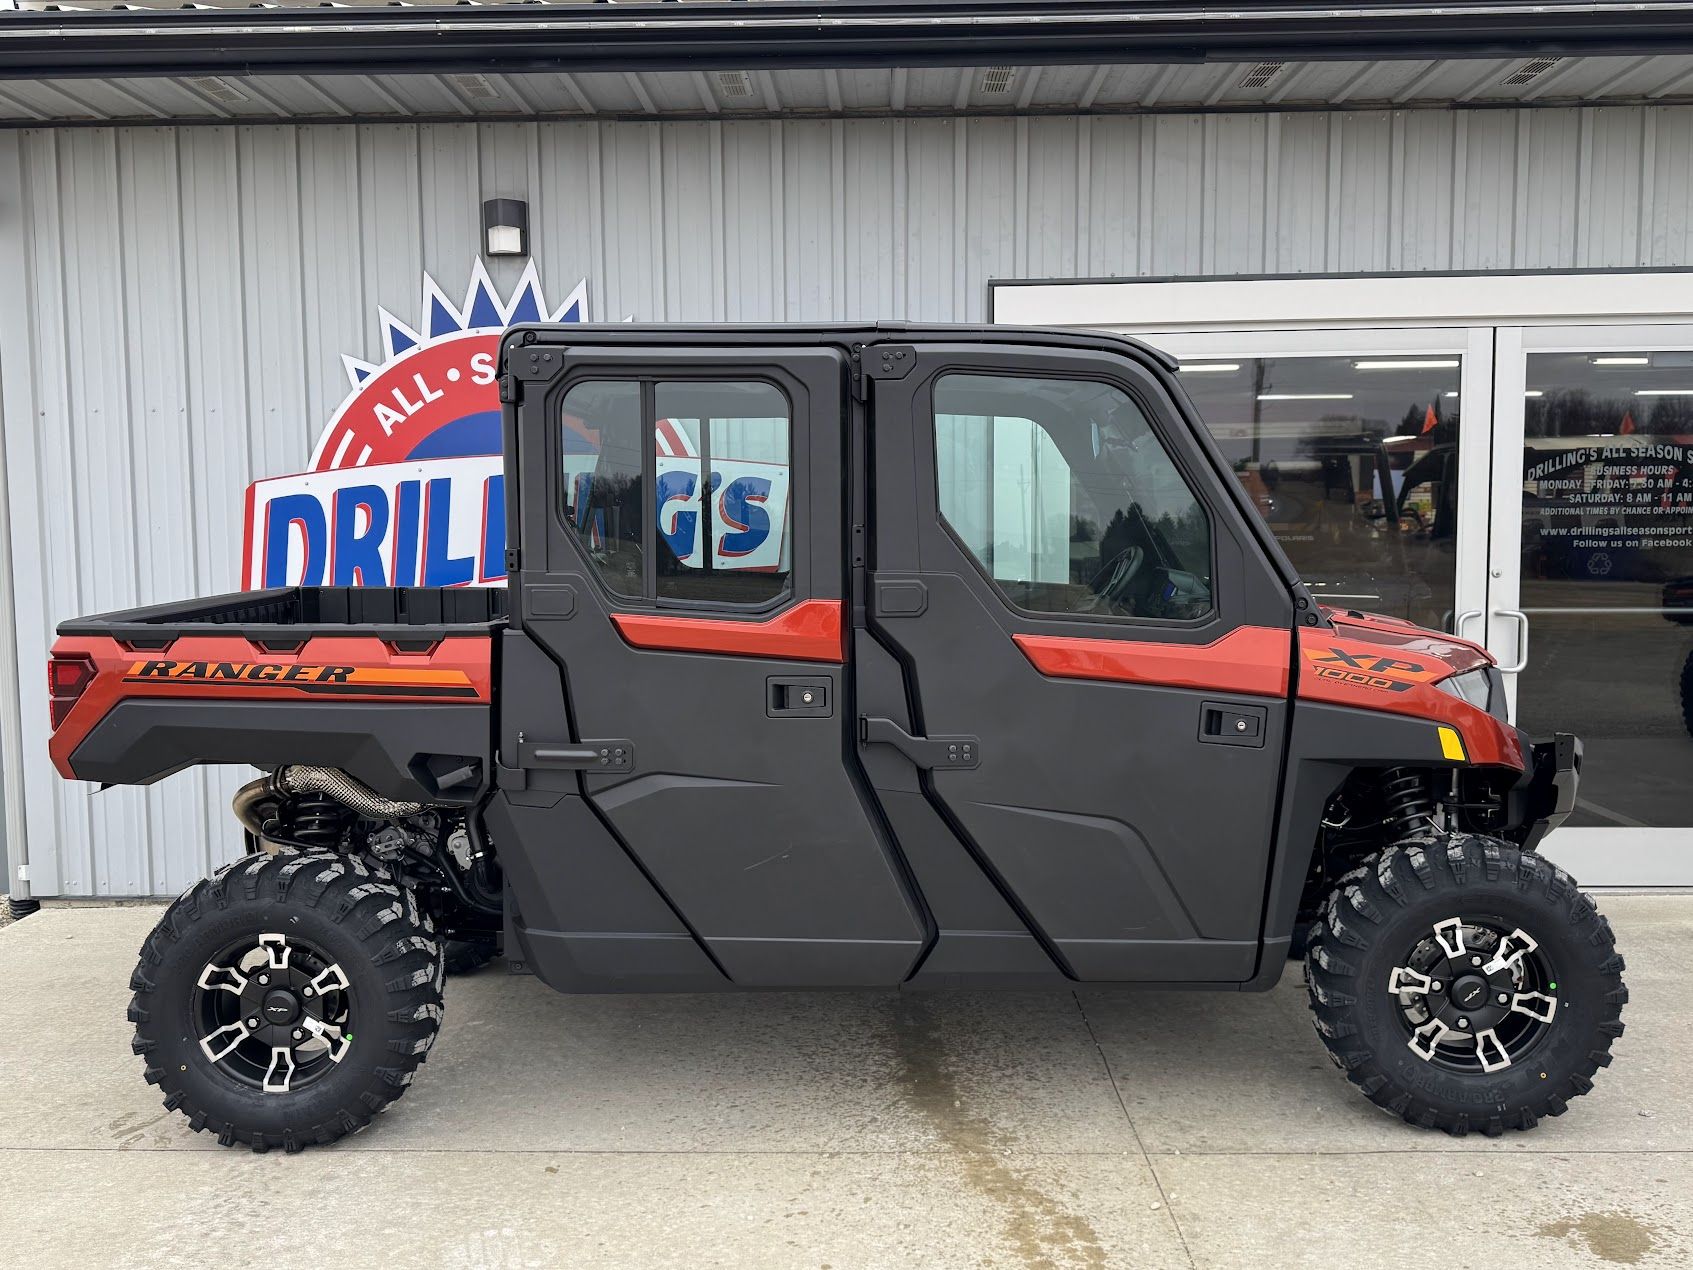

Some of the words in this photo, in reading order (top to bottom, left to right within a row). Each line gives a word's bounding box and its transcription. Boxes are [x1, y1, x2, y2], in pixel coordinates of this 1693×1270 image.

[373, 373, 444, 437] ALL
[1527, 447, 1598, 482] DRILLING'S
[1602, 445, 1626, 459] ALL
[1630, 444, 1683, 461] SEASON
[1590, 465, 1638, 476] BUSINESS
[1640, 465, 1675, 475] HOURS
[1540, 479, 1582, 489] MONDAY
[1591, 478, 1629, 489] FRIDAY:
[1657, 478, 1673, 489] AM
[1569, 493, 1624, 504] SATURDAY:
[1626, 493, 1633, 503] 8
[1636, 493, 1652, 503] AM
[1661, 492, 1673, 502] 11
[1676, 492, 1692, 502] AM
[1540, 507, 1584, 516] ADDITIONAL
[1586, 507, 1608, 515] TIMES
[1609, 507, 1620, 515] BY
[1621, 506, 1652, 515] CHANCE
[1653, 506, 1664, 515] OR
[1573, 539, 1608, 548] Follow
[1610, 539, 1623, 548] us
[1625, 539, 1639, 548] on
[1642, 538, 1692, 547] Facebook
[1313, 647, 1425, 673] XP
[138, 660, 356, 683] RANGER
[1312, 664, 1394, 690] 1000
